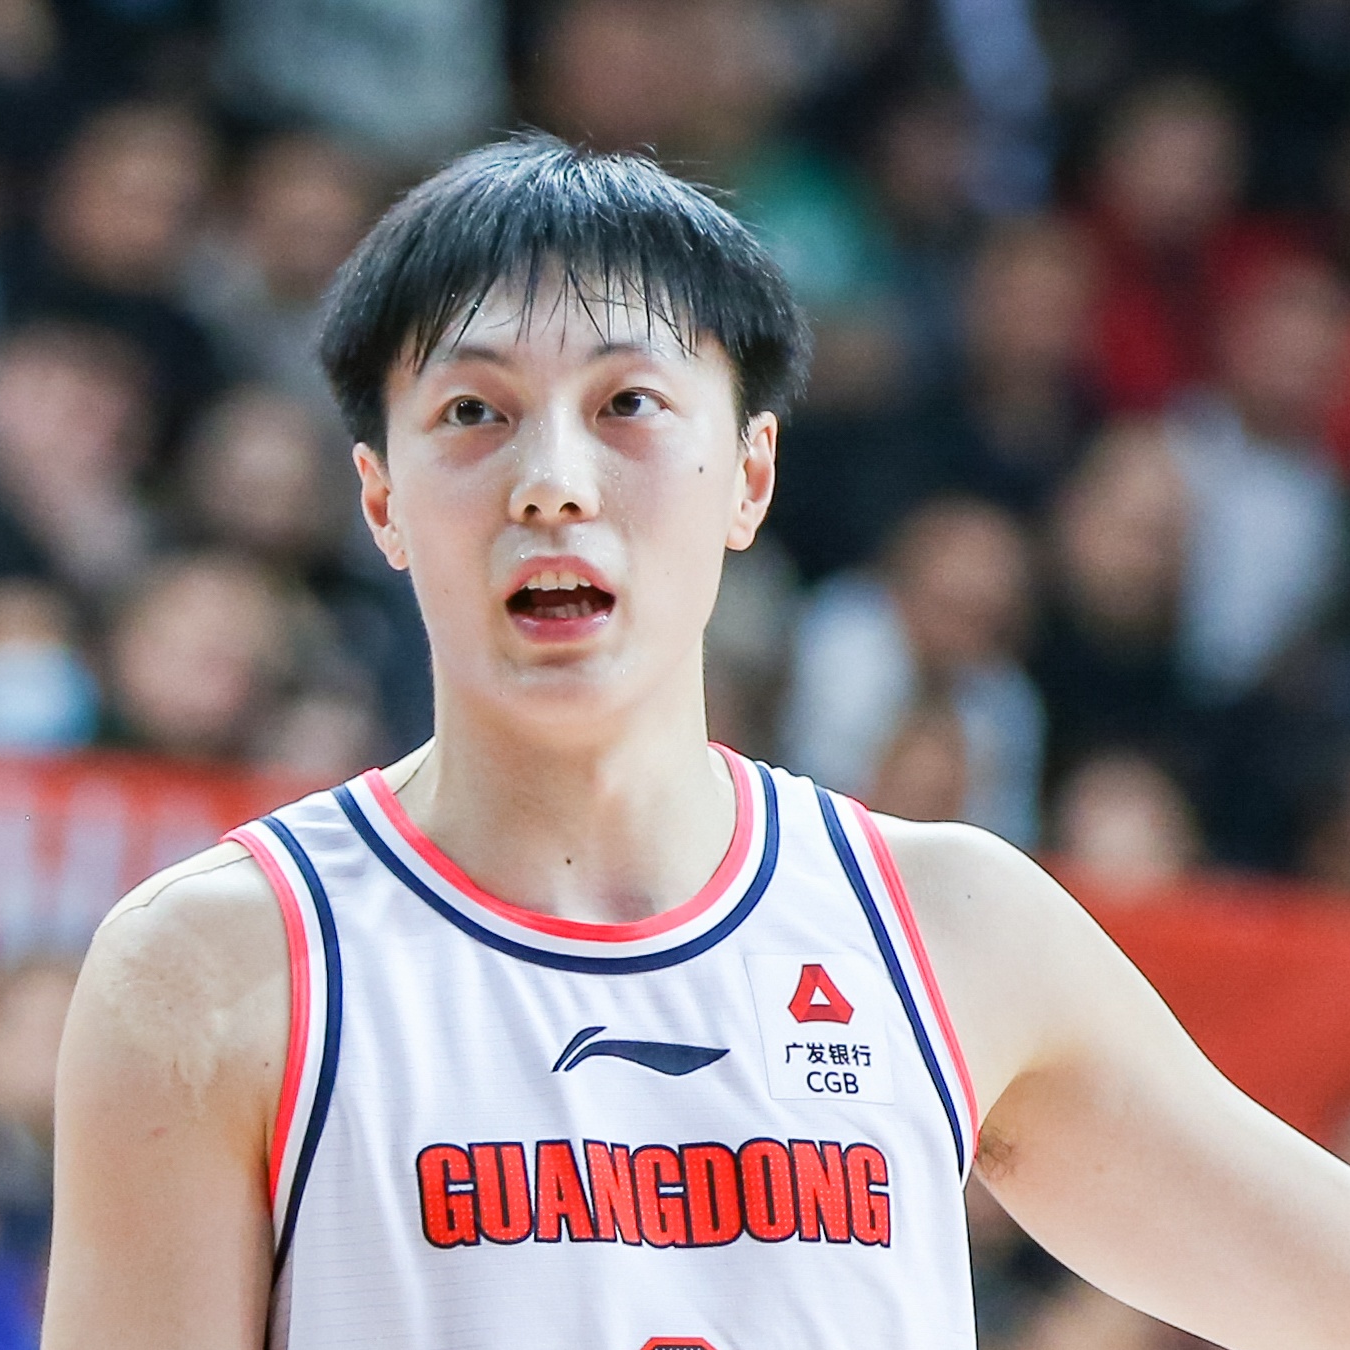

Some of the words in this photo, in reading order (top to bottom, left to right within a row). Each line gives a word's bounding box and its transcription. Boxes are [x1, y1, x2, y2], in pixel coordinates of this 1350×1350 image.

[785, 1042, 871, 1067] 广发银行
[806, 1071, 859, 1094] CGB
[416, 1138, 891, 1248] GUANGDONG
